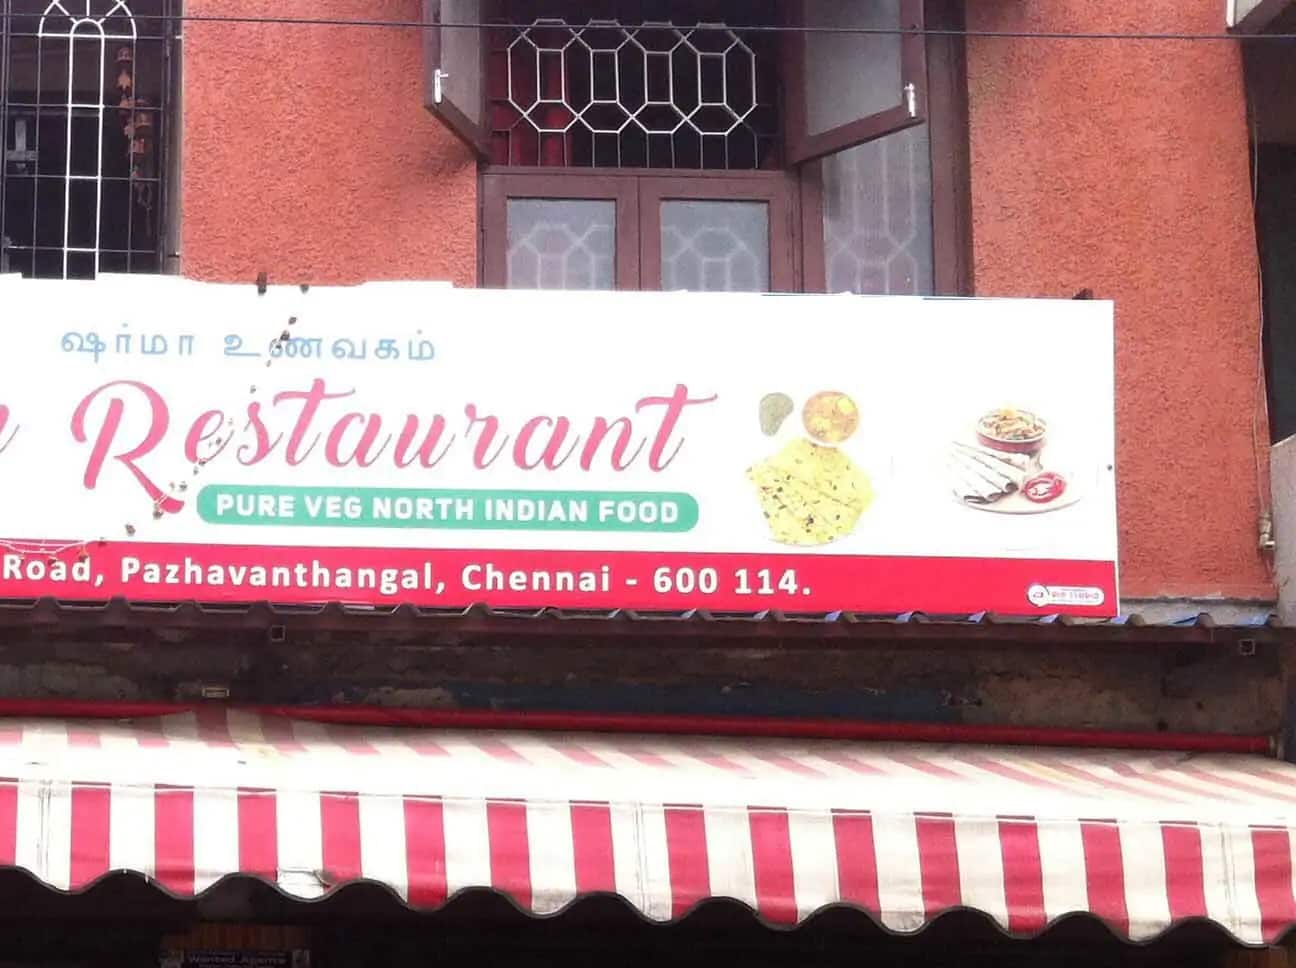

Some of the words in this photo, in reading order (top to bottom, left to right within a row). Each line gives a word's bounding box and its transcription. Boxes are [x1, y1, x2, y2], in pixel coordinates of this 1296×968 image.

[61, 323, 195, 364] ஷர்மா
[70, 377, 718, 514] Restaurant
[217, 494, 295, 518] PURE
[304, 495, 362, 520] VEG
[372, 496, 474, 521] NORTH
[485, 498, 588, 523] INDIAN
[599, 500, 679, 524] FOOD
[4, 553, 104, 585] Road,
[121, 555, 446, 594] Pazhavanthangal,
[462, 563, 611, 592] Chennai
[653, 566, 718, 594] 600
[734, 569, 811, 596] 114.
